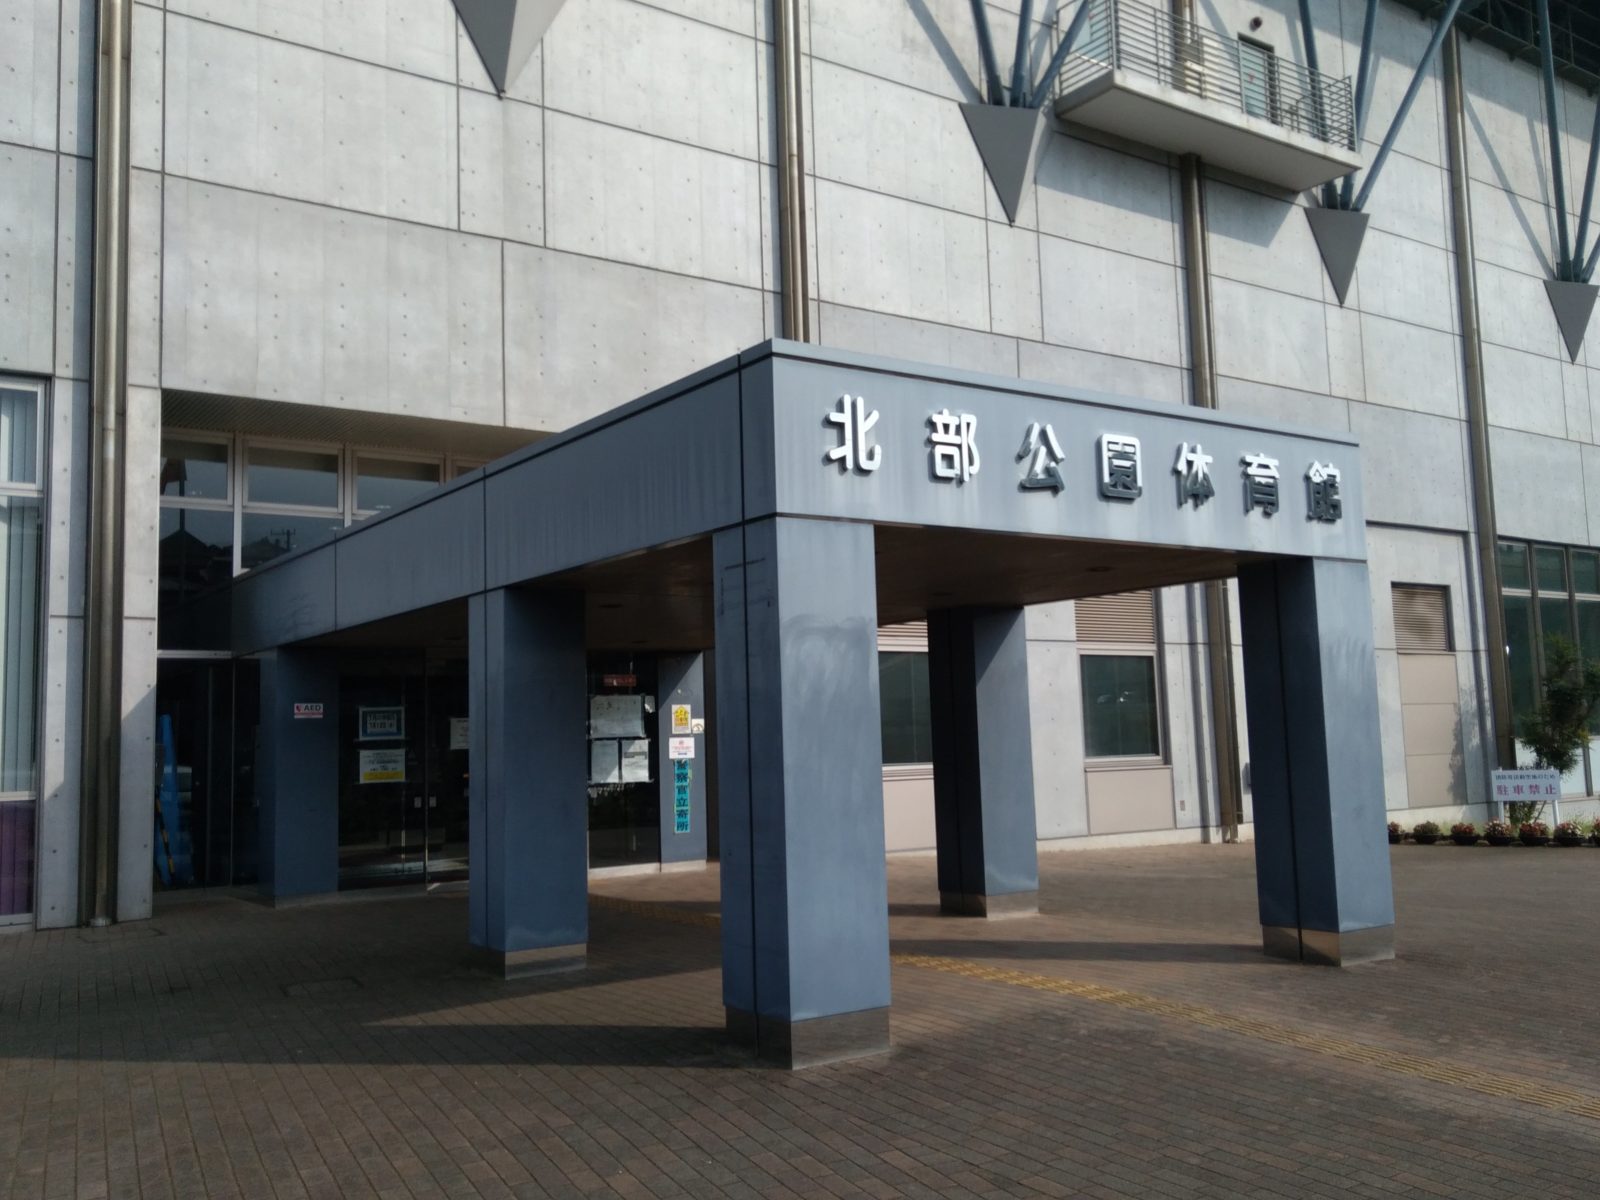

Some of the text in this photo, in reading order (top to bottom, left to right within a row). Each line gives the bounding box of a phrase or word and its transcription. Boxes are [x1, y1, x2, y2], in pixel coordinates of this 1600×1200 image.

[825, 393, 1343, 522] 北部公園体育館
[1496, 784, 1557, 795] 駐車禁止
